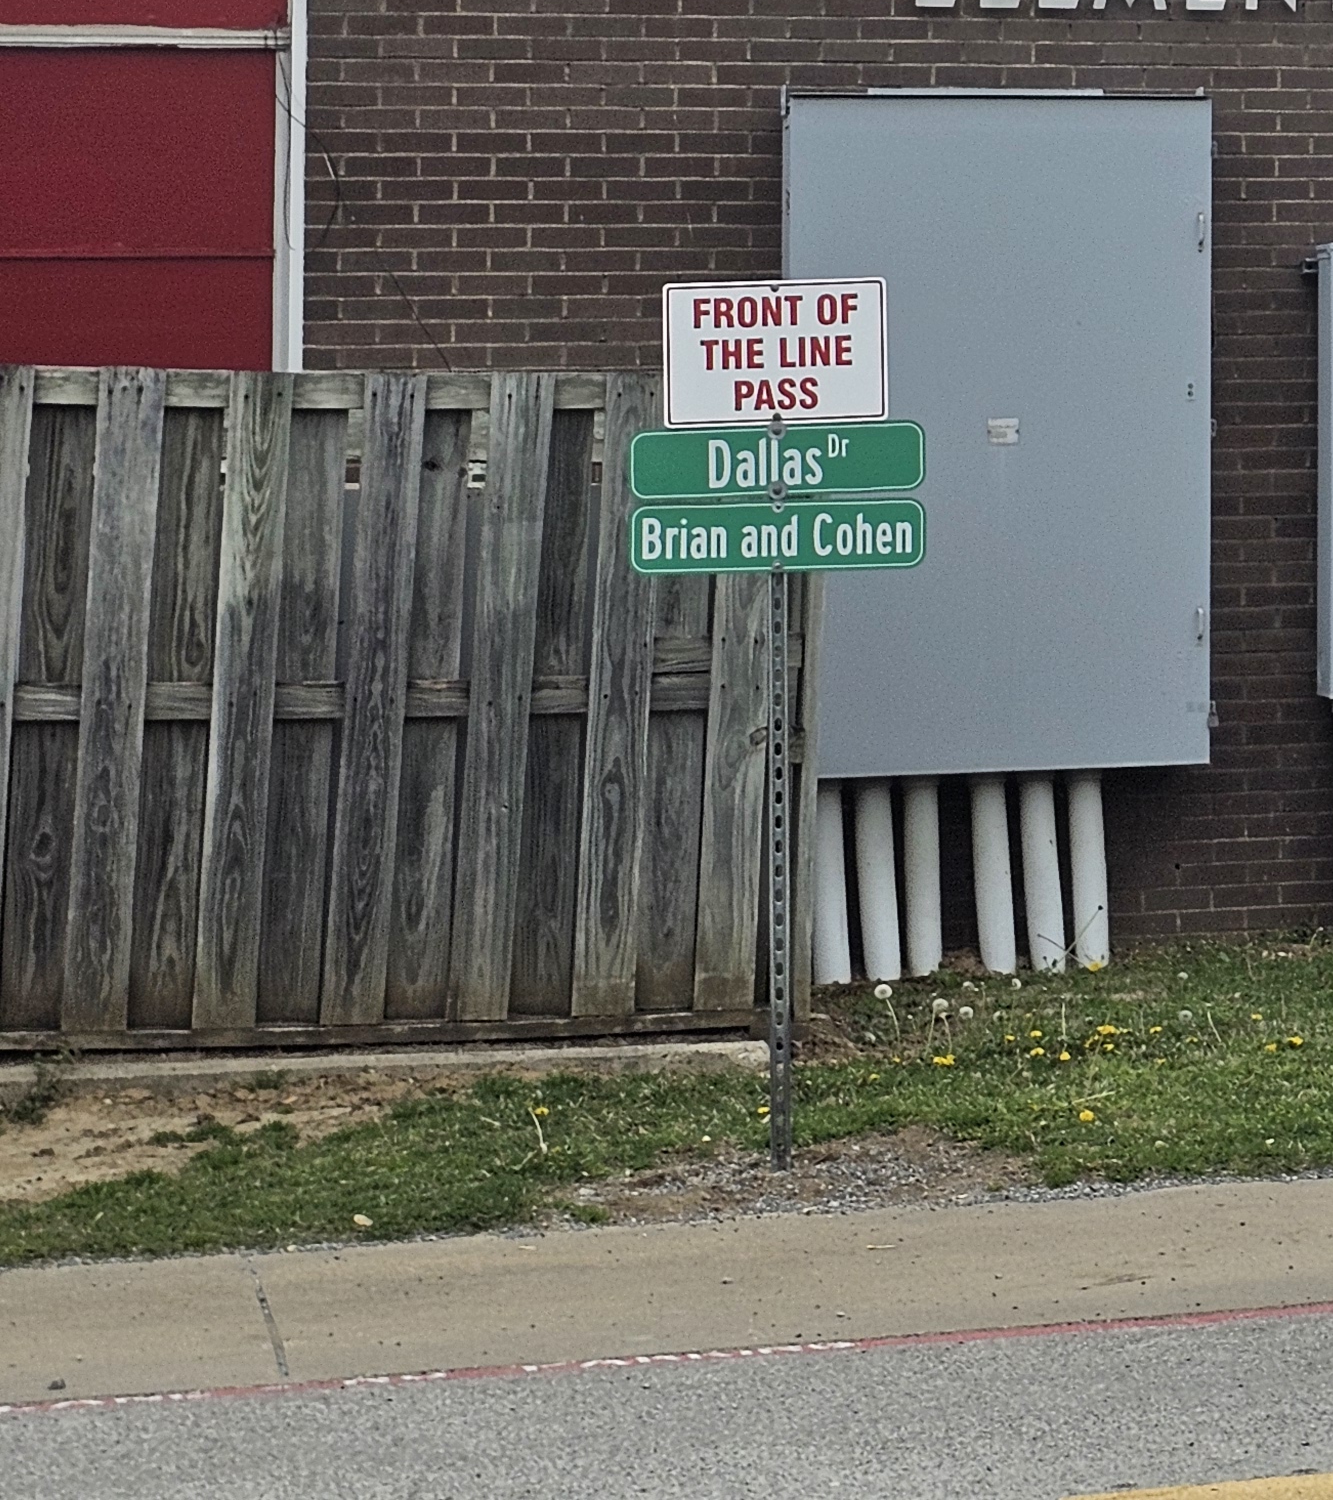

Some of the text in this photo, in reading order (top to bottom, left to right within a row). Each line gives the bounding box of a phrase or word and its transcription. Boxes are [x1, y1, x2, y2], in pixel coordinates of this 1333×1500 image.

[693, 293, 858, 329] FRONT OF
[700, 335, 853, 370] THE LINE
[734, 377, 819, 411] PASS
[708, 433, 850, 489] Dallas Dr
[641, 512, 913, 560] Brian and Cohen
